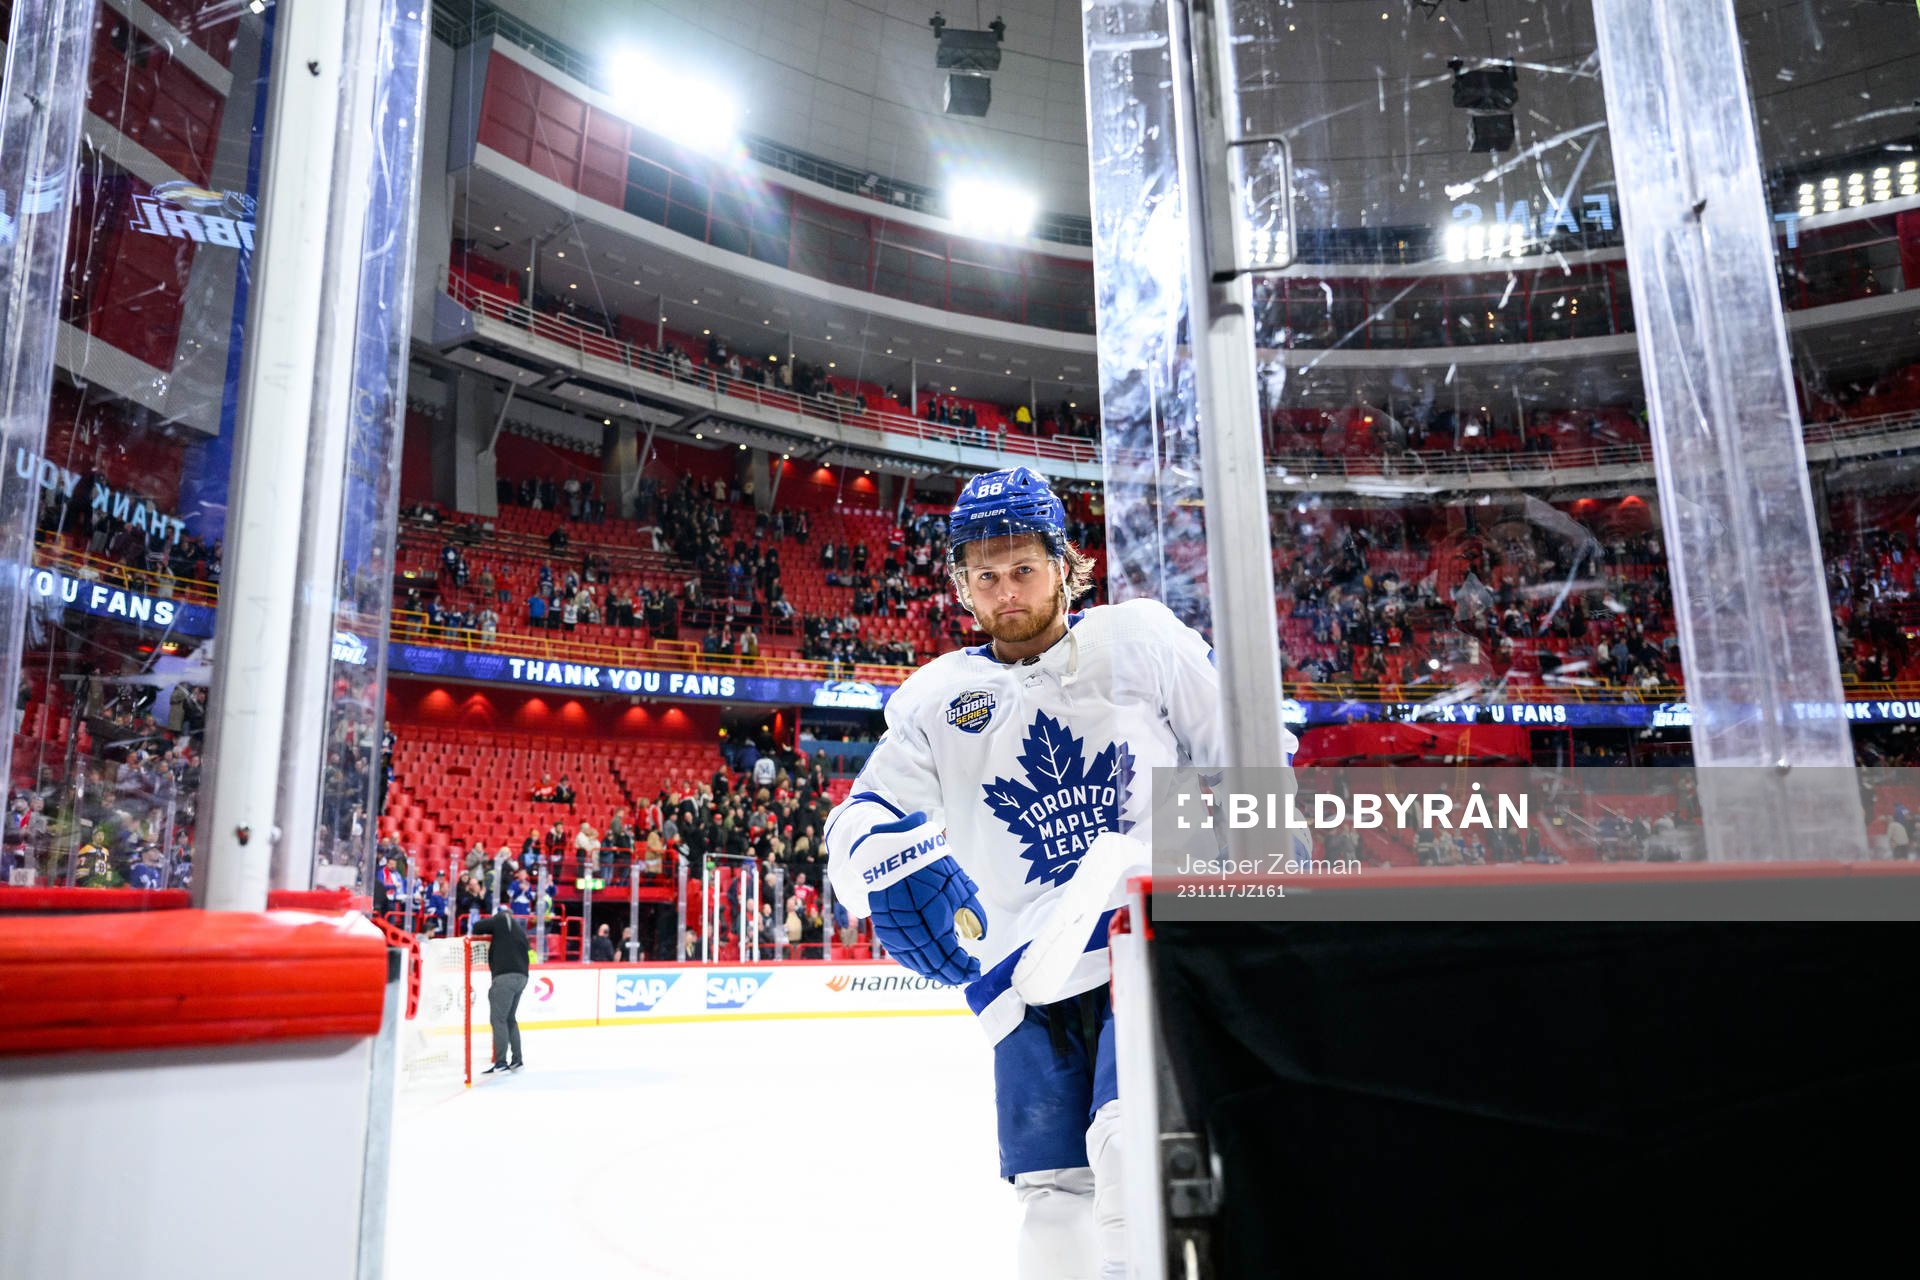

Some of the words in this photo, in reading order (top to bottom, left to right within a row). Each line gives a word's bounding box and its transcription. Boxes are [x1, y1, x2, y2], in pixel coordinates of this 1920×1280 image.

[976, 483, 1003, 499] 88
[970, 508, 1007, 520] BAUER
[90, 585, 175, 625] FANS
[509, 658, 600, 688] THANK
[608, 669, 660, 692] YOU
[669, 673, 736, 697] FANS
[946, 693, 996, 724] GLOBAL
[956, 707, 988, 725] SERIES
[1512, 704, 1567, 723] FANS
[1793, 702, 1871, 720] THANK
[1018, 785, 1116, 829] TORONTO
[1038, 806, 1107, 841] MAPLE
[616, 979, 667, 1007] SAP
[707, 977, 760, 1004] SAP
